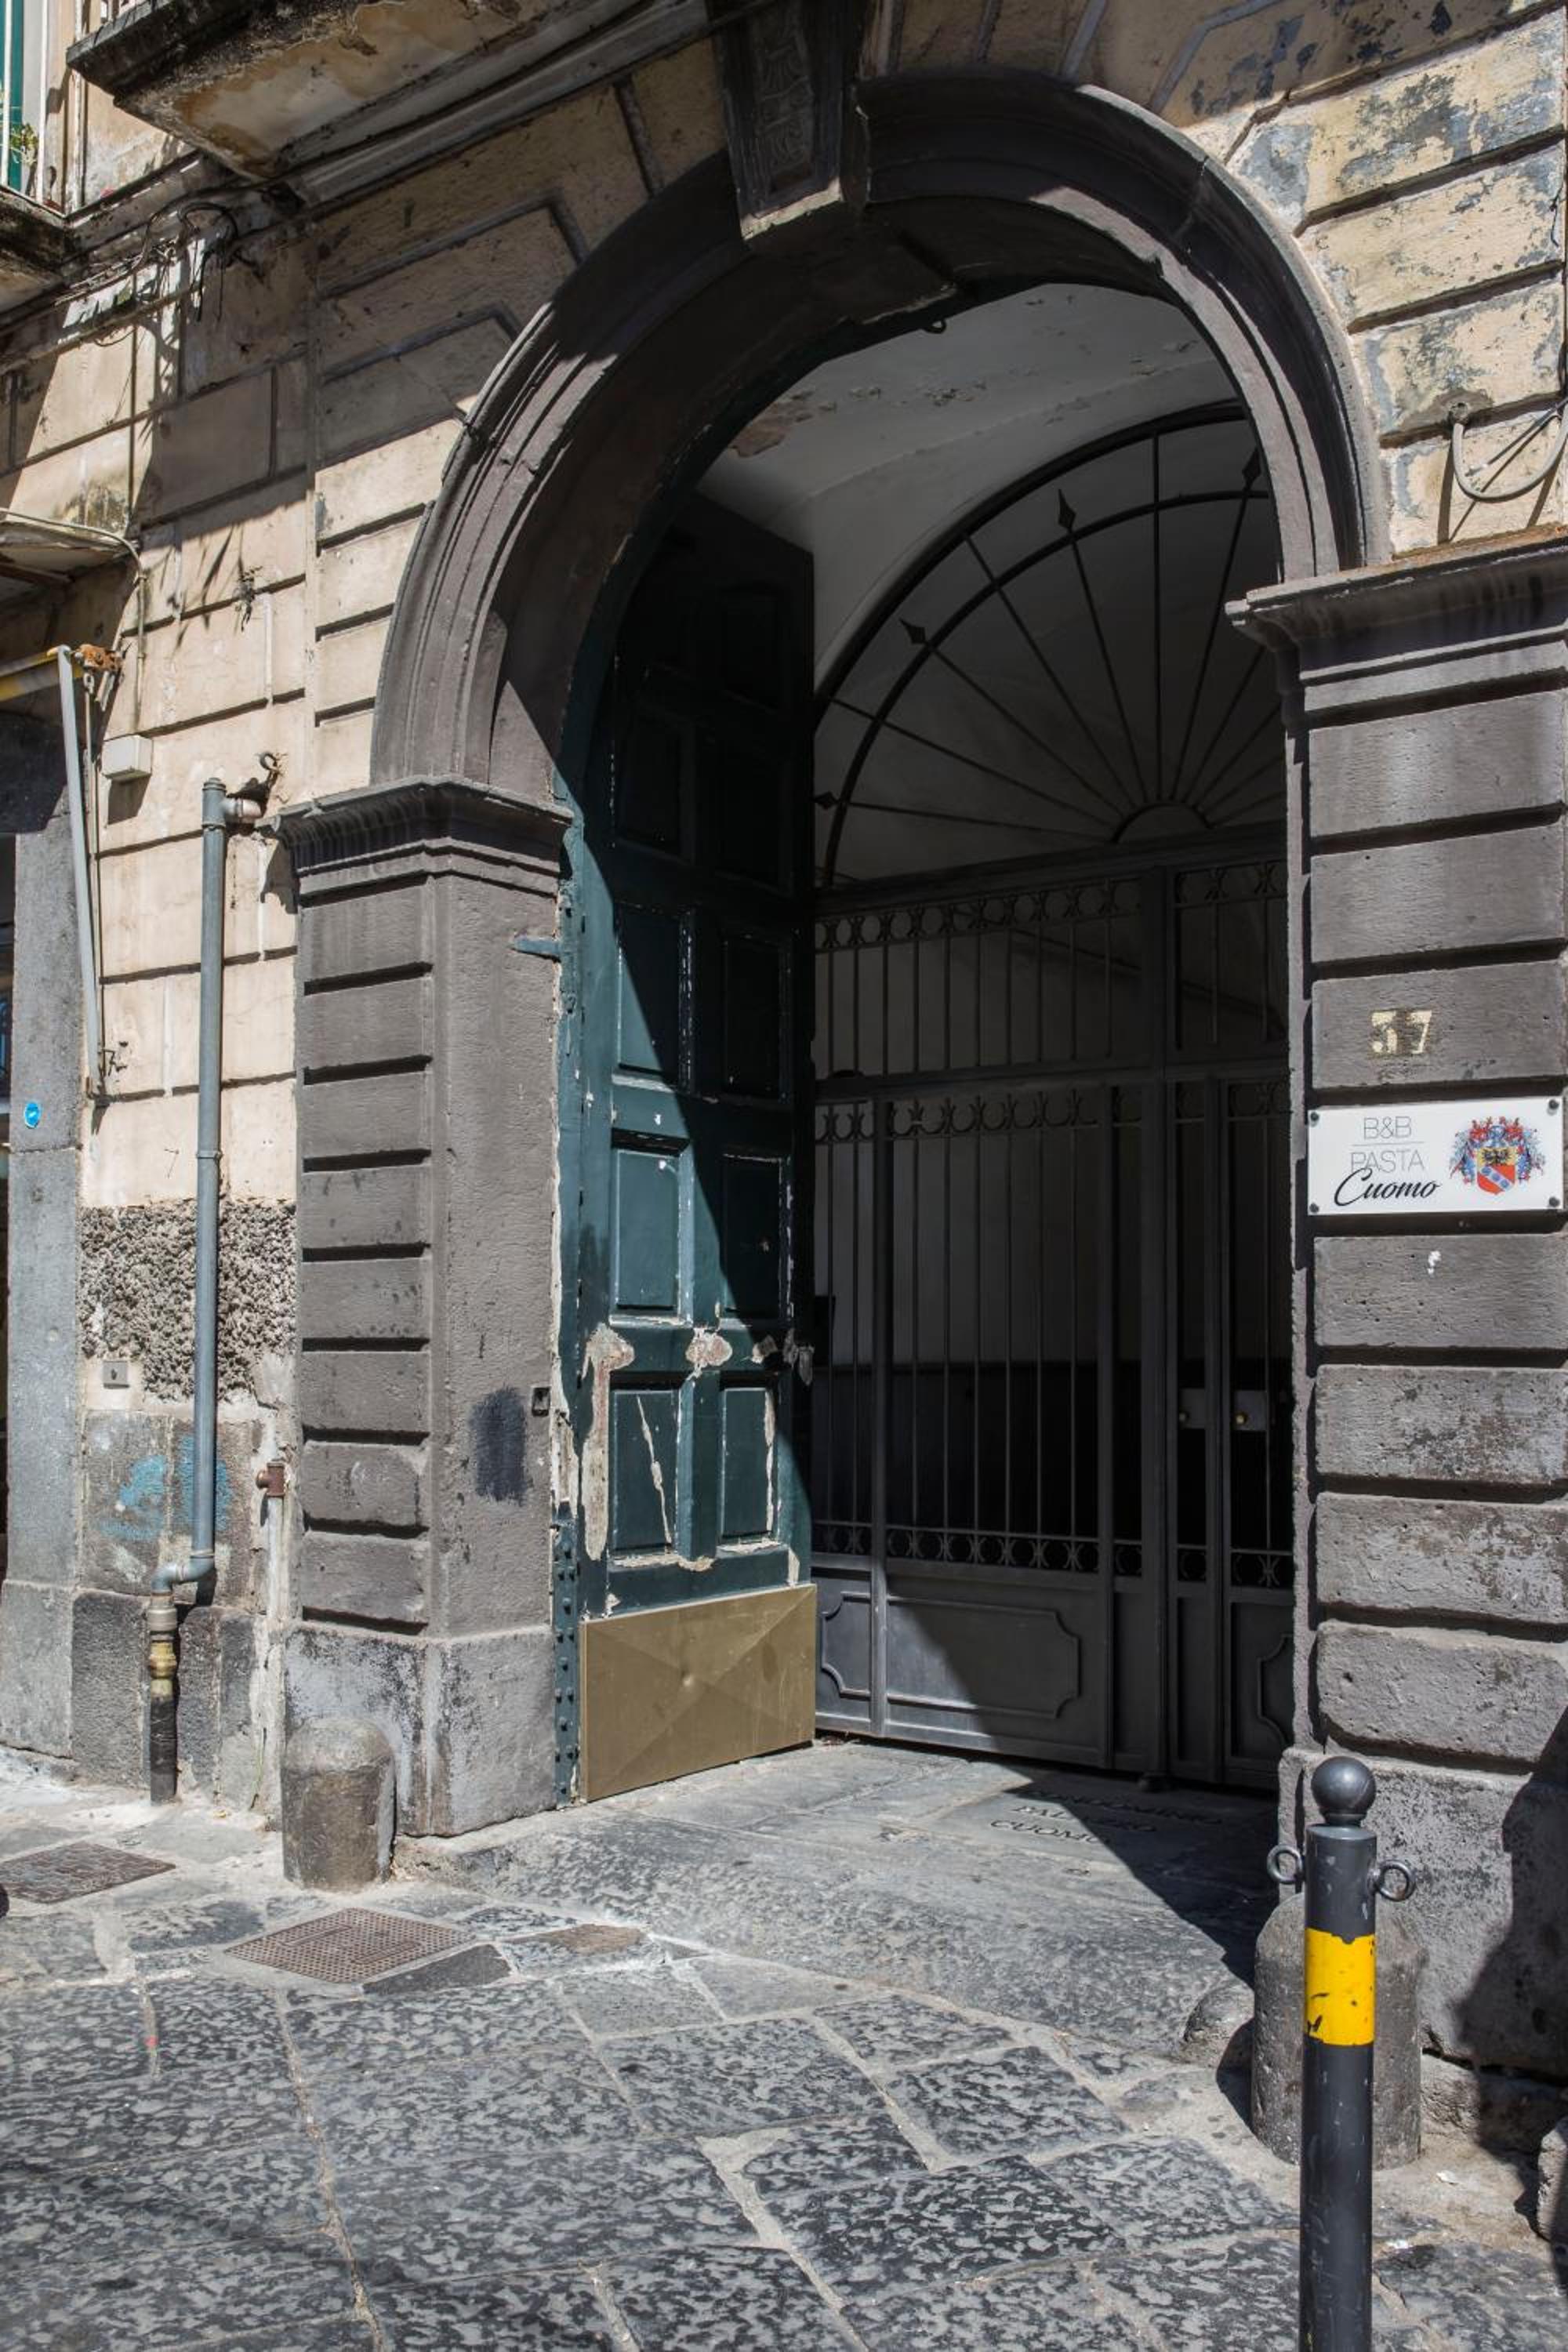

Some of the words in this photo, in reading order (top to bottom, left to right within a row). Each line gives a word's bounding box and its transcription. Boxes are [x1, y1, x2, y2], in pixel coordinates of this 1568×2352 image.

[1363, 1116, 1413, 1141] B&B
[1350, 1149, 1425, 1174] PASTA
[1334, 1167, 1441, 1207] Cuomo
[990, 1820, 1111, 1843] CUOMO
